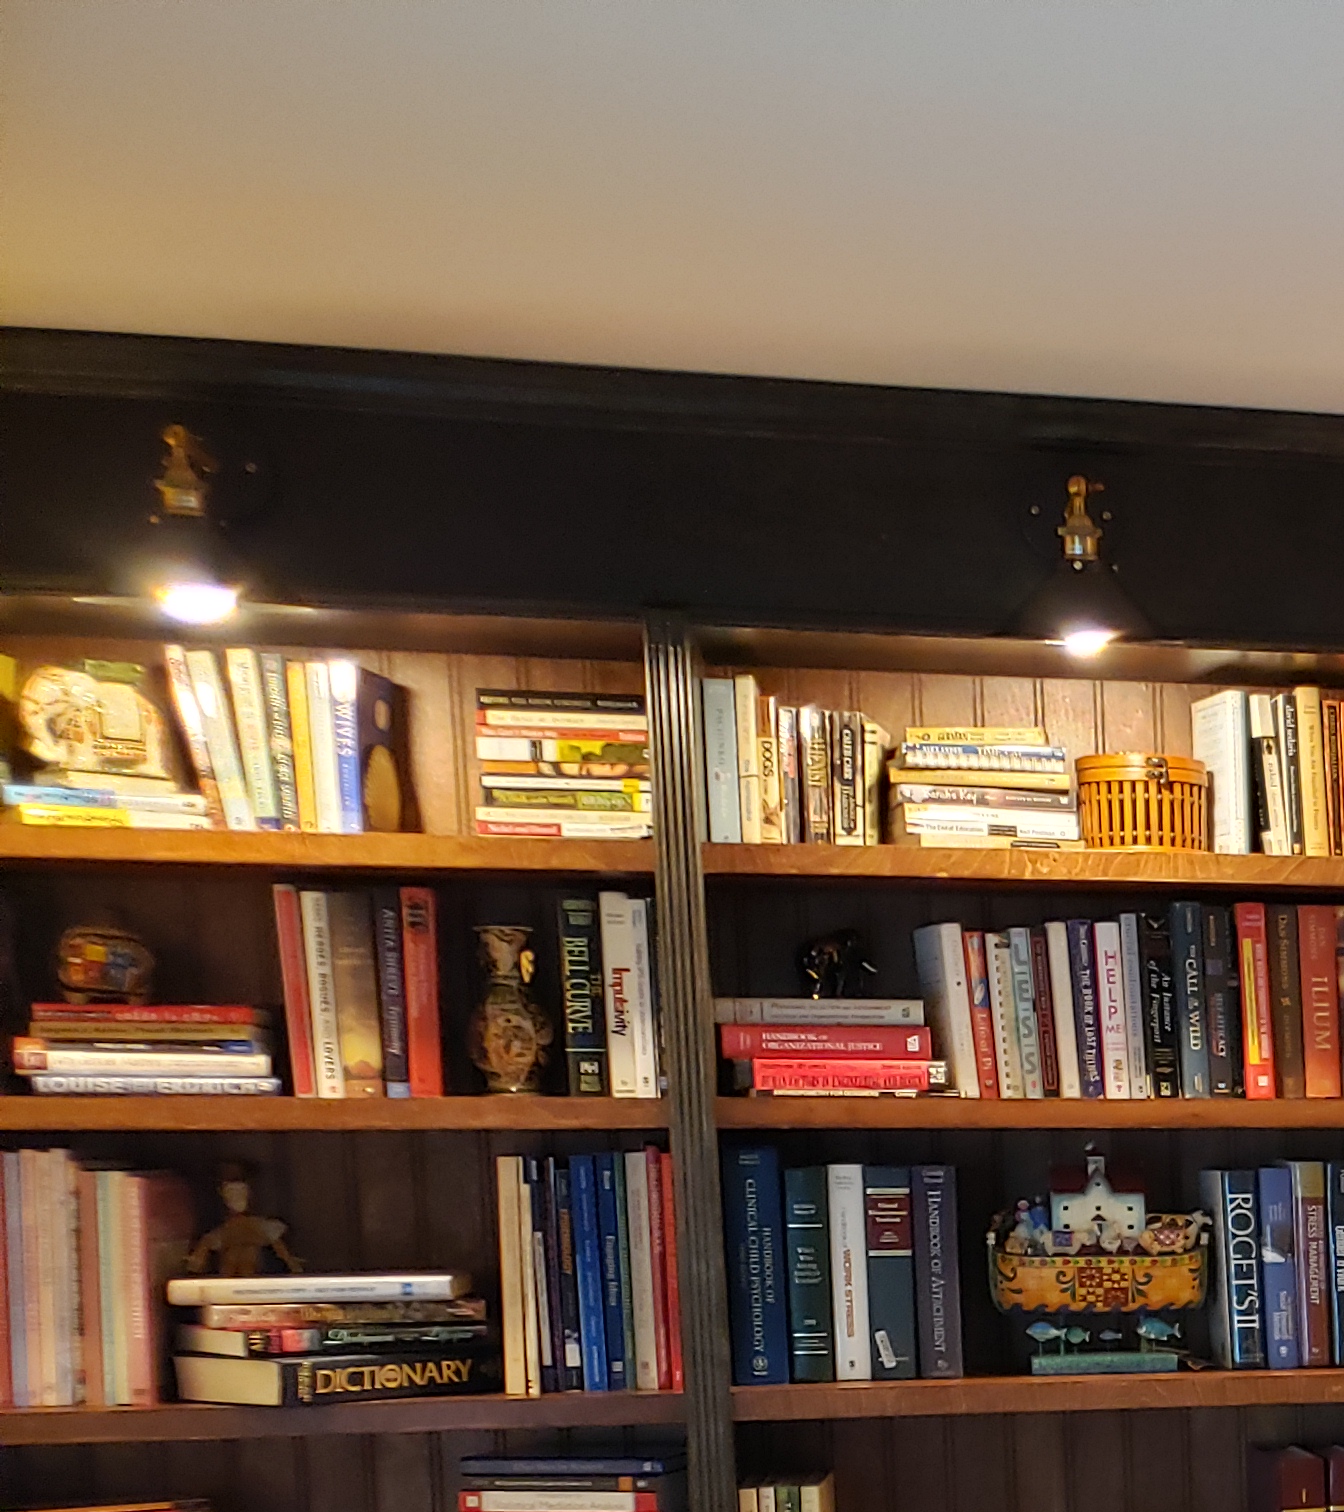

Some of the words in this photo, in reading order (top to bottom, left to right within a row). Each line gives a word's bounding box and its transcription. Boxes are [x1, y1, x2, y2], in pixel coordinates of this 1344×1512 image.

[1284, 705, 1295, 727] david
[761, 741, 774, 777] DOGS
[563, 937, 588, 975] BELL
[1185, 959, 1199, 994] CALL
[566, 979, 593, 1033] CURVE
[1311, 977, 1331, 1050] ILIUM
[1189, 1012, 1202, 1050] WILD
[745, 1179, 758, 1232] CLINICAL
[1307, 1206, 1318, 1238] STRESS
[749, 1237, 760, 1273] CHILD
[762, 1228, 774, 1287] HANDBOOK
[1227, 1193, 1259, 1311] ROGET'S
[765, 1289, 775, 1304] OF
[315, 1359, 472, 1394] DICTIONARY
